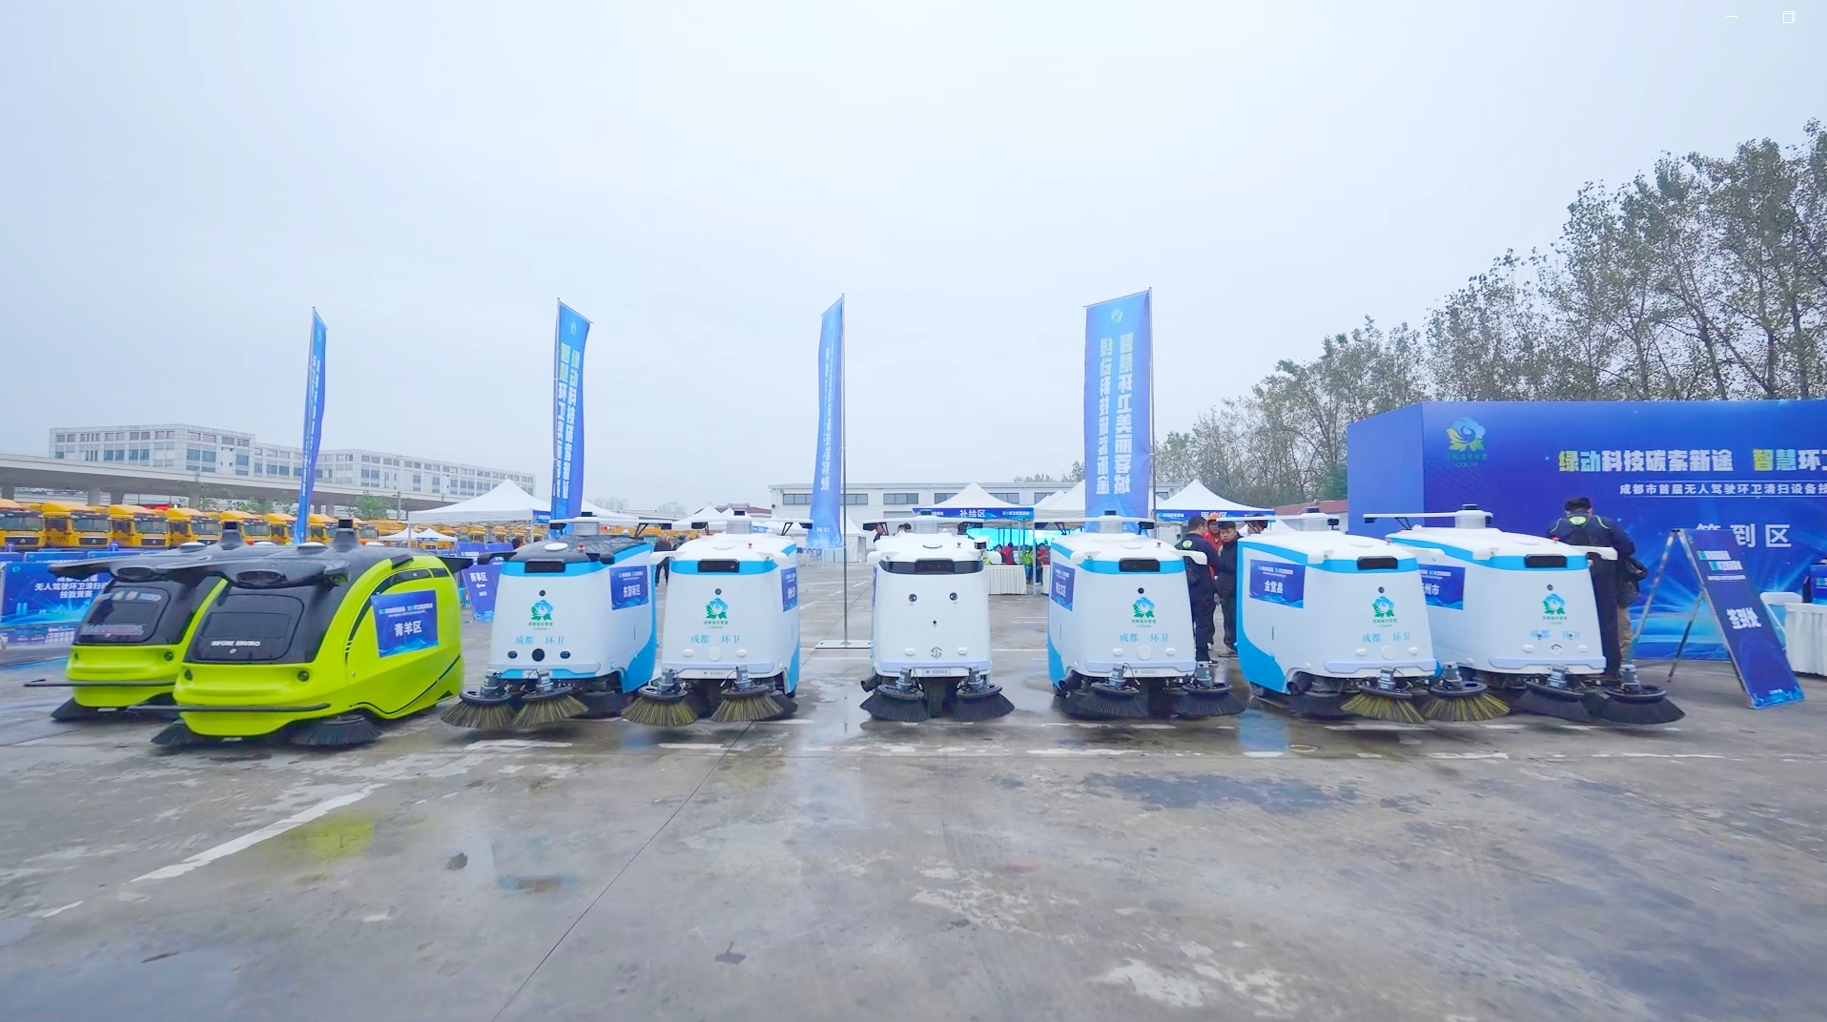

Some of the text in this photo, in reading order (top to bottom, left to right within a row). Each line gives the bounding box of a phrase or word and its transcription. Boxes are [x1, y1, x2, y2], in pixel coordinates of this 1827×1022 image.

[1559, 449, 1827, 472] 绿动科技碳索新途 智慧环
[960, 509, 986, 518] 补给区
[1726, 607, 1762, 629] 签到处
[394, 620, 422, 637] 青羊区
[515, 636, 564, 645] 成都 环卫
[691, 634, 740, 644] 成都 环卫
[1119, 633, 1169, 643] 成都 环卫
